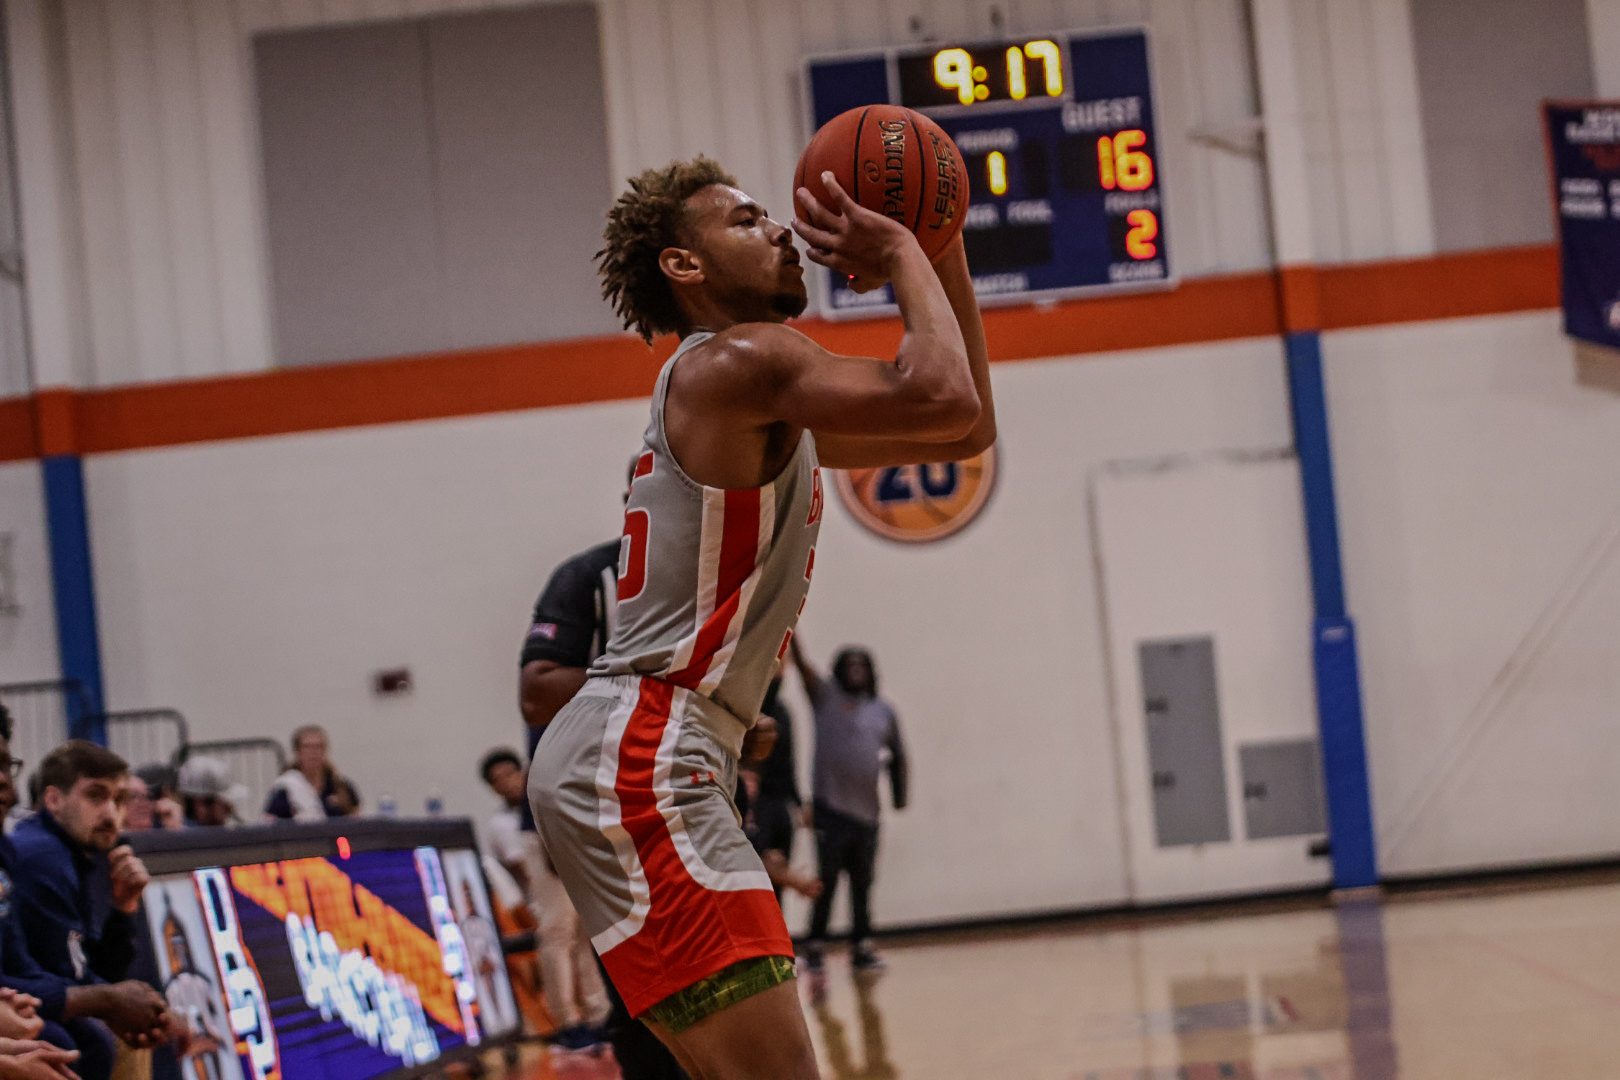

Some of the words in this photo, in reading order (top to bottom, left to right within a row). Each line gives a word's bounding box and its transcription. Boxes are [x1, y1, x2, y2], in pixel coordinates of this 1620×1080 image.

[933, 40, 1063, 105] 9:17
[1062, 96, 1140, 132] GUEST
[879, 120, 907, 225] PALDING
[928, 131, 952, 230] LEGACY
[986, 150, 1008, 196] 1
[1097, 129, 1154, 191] 16
[1126, 209, 1158, 260] 2
